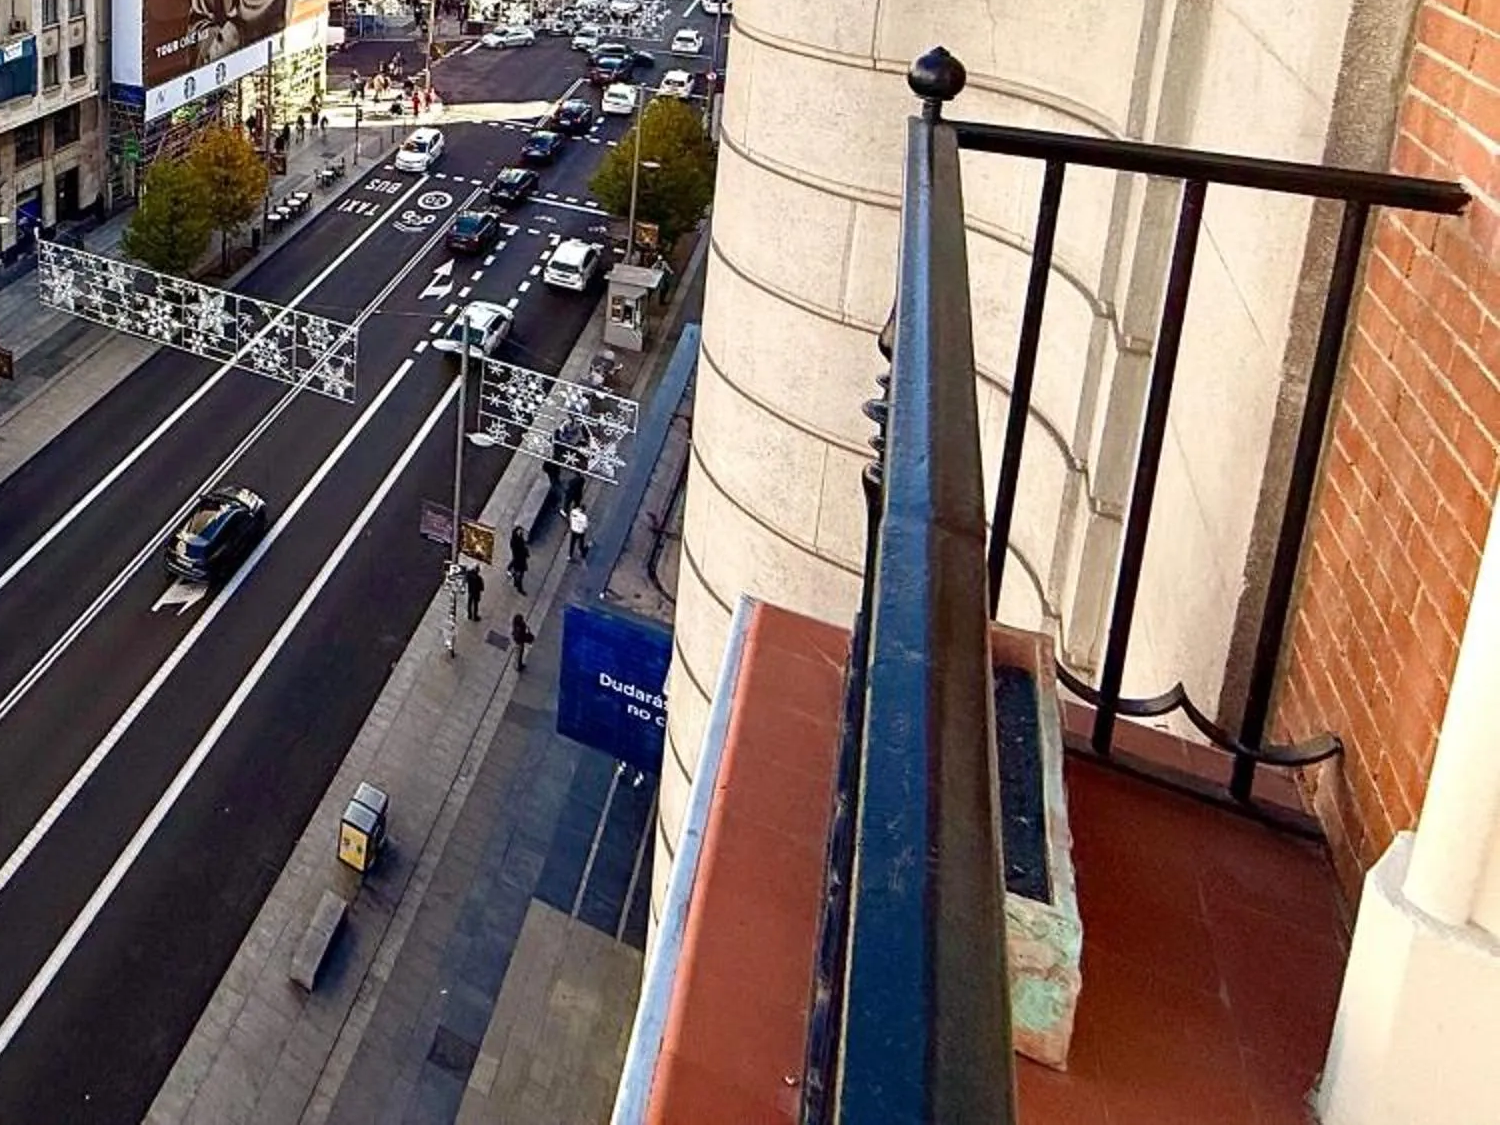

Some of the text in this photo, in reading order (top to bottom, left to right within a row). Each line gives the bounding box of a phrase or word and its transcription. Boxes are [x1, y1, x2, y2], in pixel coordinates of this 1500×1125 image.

[364, 178, 403, 194] BUS
[337, 198, 380, 216] TAXI
[627, 703, 651, 720] no
